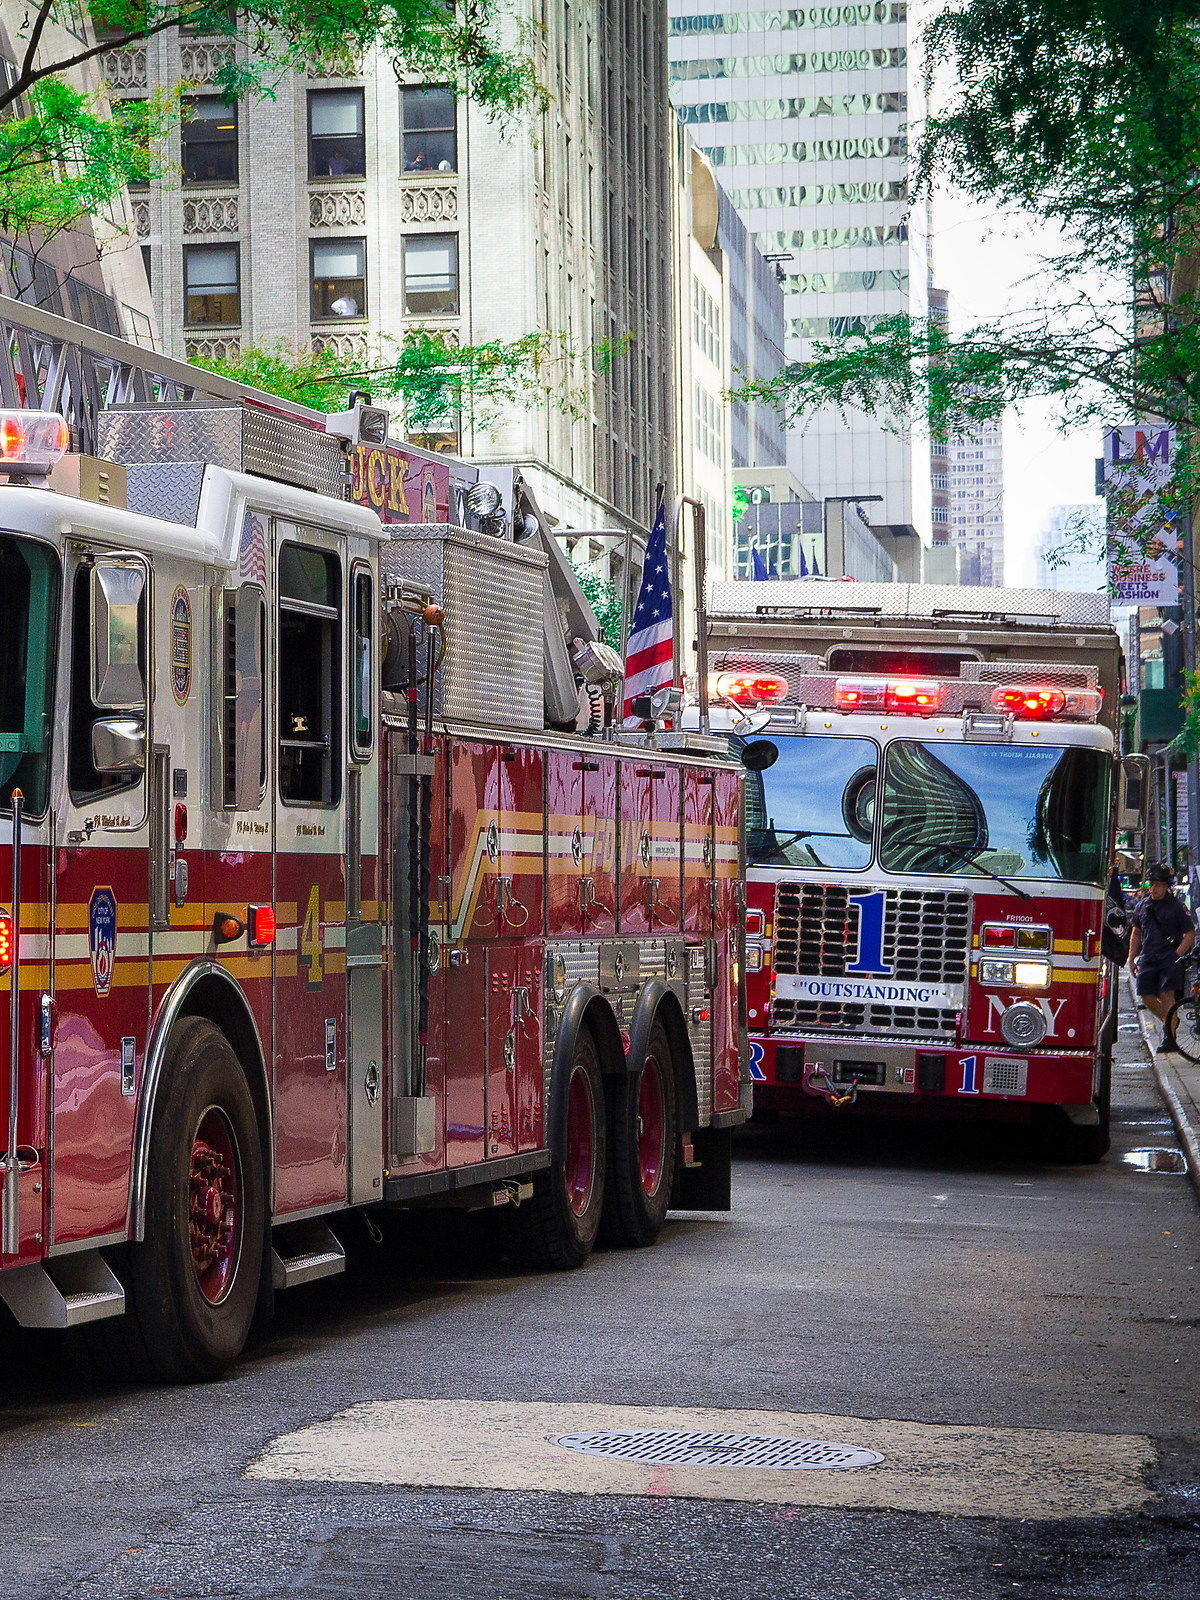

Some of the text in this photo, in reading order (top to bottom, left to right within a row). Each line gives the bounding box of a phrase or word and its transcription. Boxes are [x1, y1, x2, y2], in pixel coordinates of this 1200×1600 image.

[301, 884, 323, 984] 4
[845, 891, 894, 975] 1
[1006, 914, 1034, 923] FR11001
[800, 981, 940, 1002] "OUTSTANDING"
[958, 1055, 980, 1094] 1
